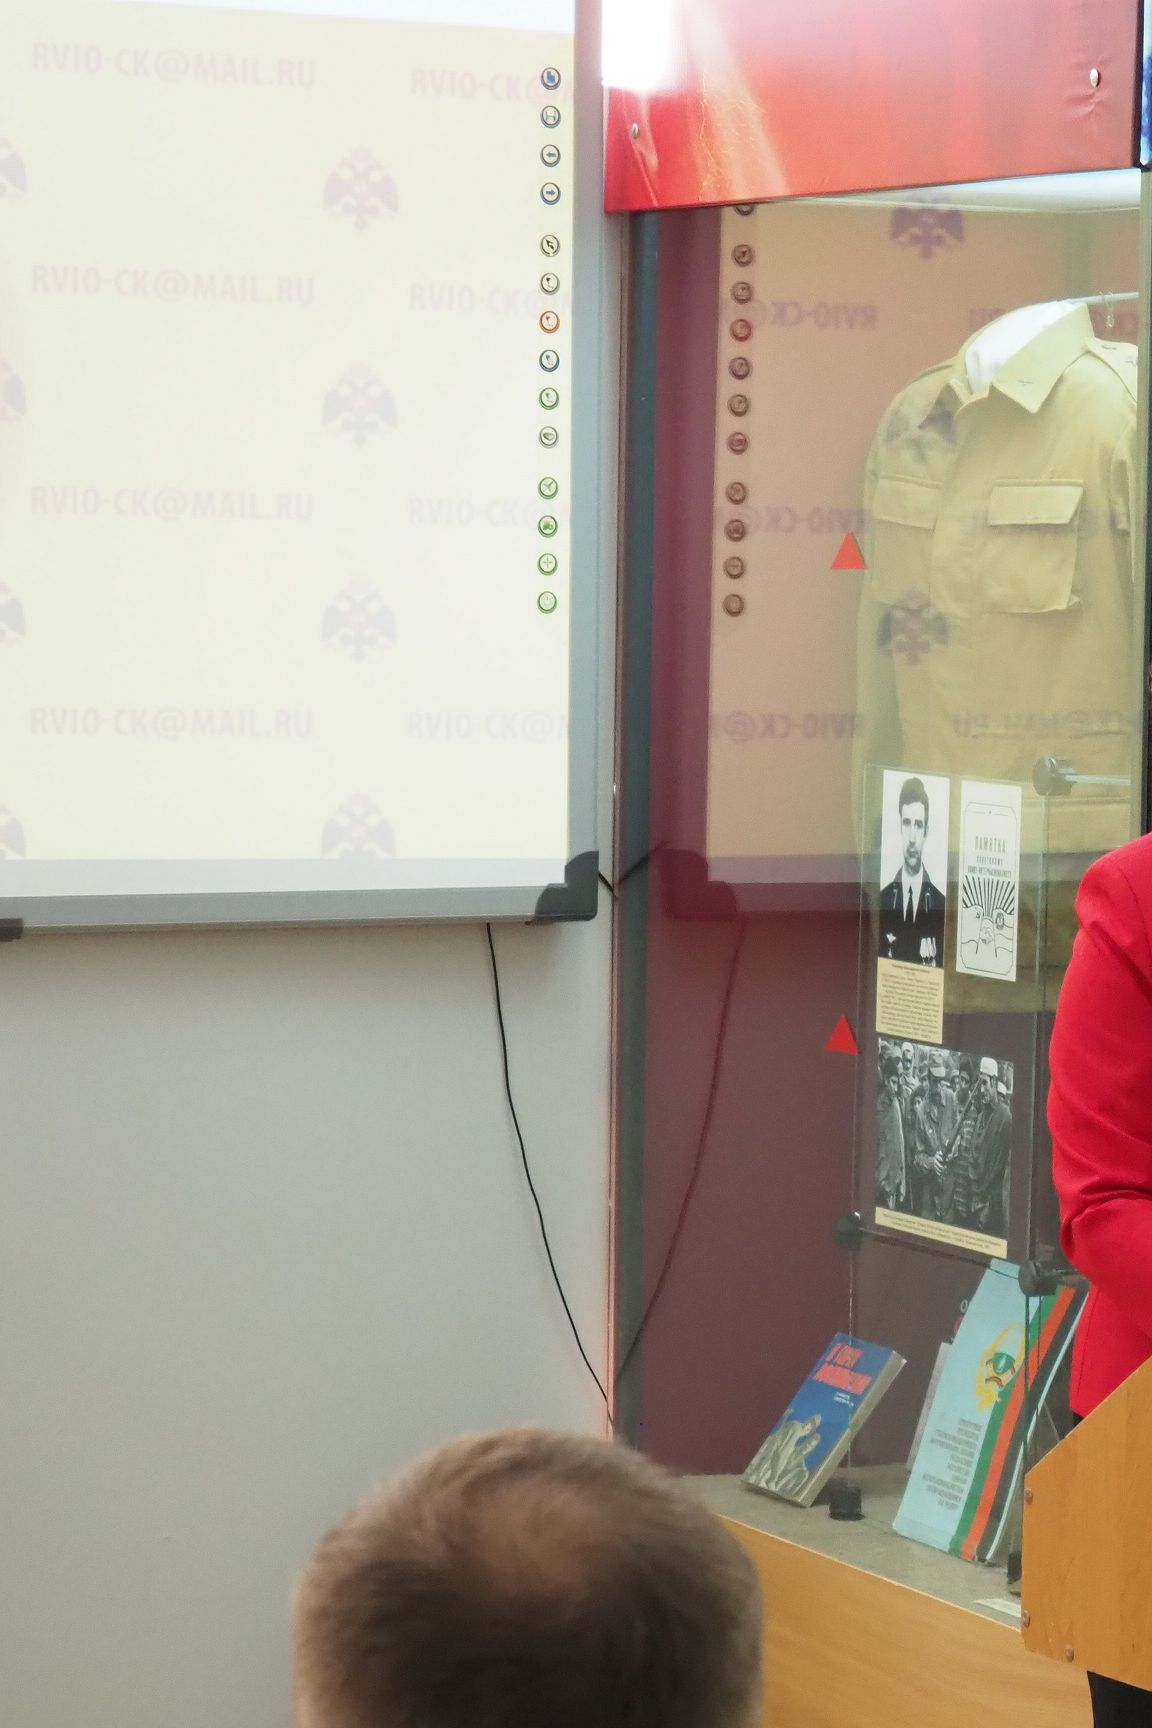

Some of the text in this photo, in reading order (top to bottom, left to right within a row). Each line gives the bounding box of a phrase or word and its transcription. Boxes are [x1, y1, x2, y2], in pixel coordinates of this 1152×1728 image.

[31, 41, 318, 89] RVIO-CK@MAIL.RU
[31, 262, 316, 305] RVIO-CK@MAIL.RU
[30, 485, 315, 523] RVIO-CK@MAIL.RU
[29, 706, 314, 742] RVIO-CK@MAIL.RU
